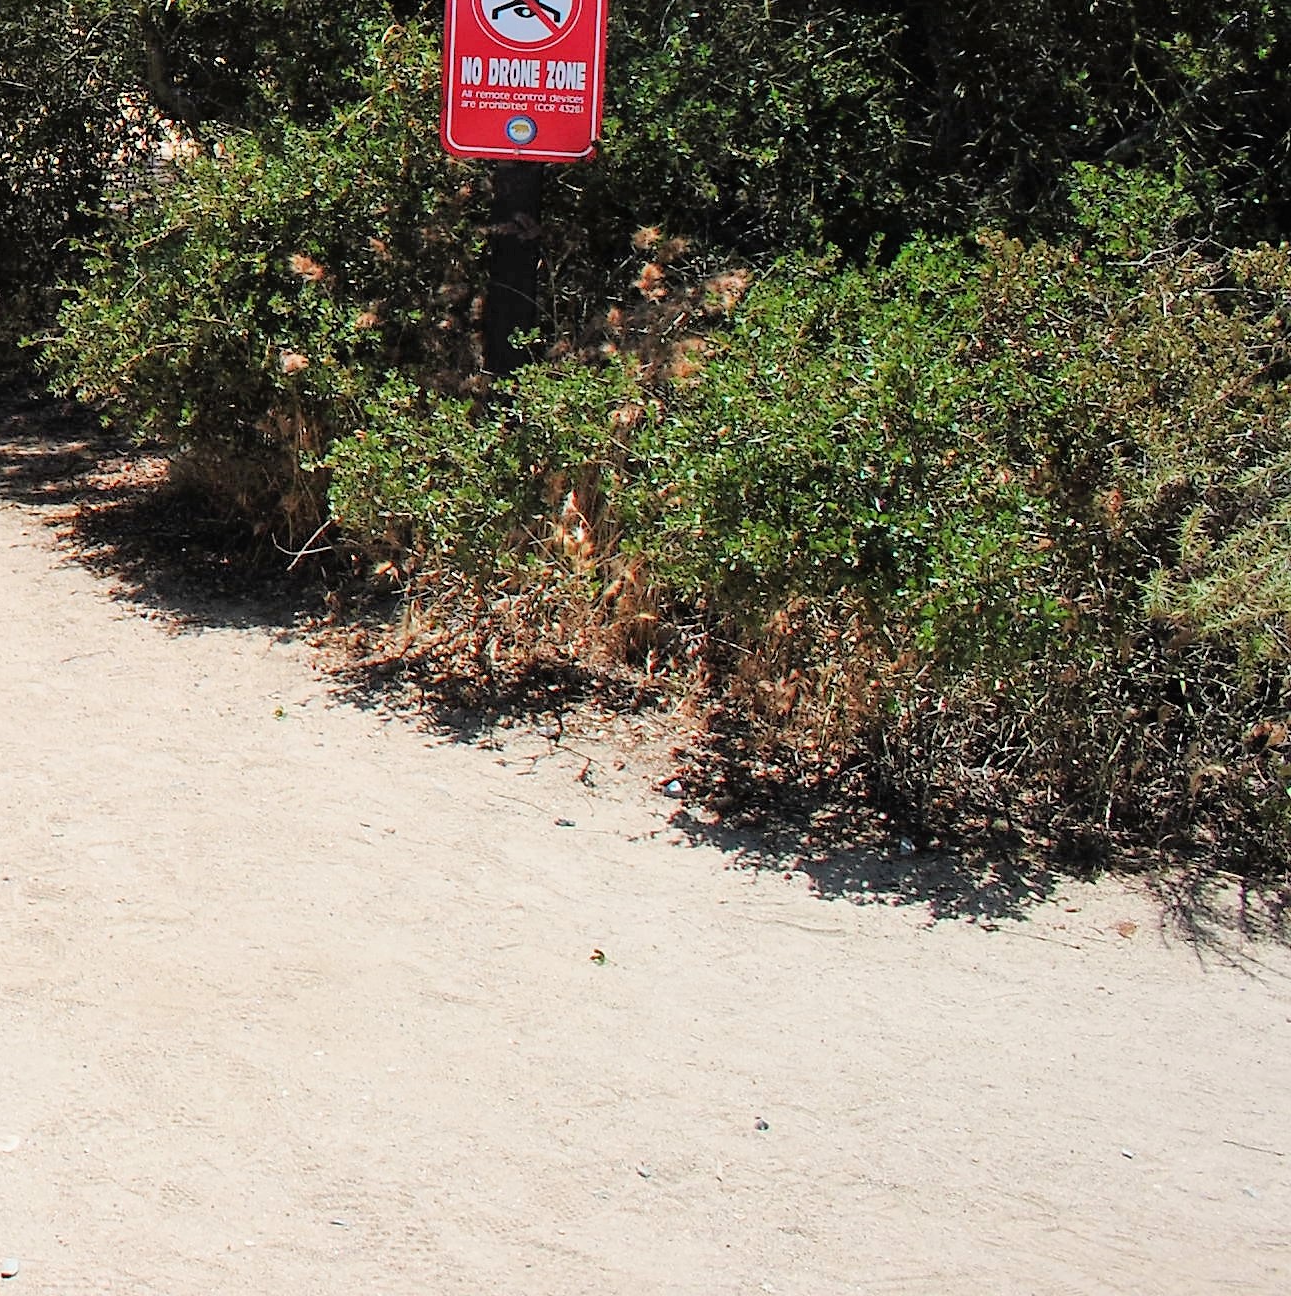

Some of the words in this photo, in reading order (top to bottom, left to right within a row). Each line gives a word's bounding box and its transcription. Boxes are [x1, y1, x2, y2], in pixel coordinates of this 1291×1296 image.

[461, 56, 483, 85] NO
[488, 57, 540, 89] DRONE
[545, 60, 587, 91] ZONE
[461, 89, 473, 98] All
[475, 90, 511, 101] remote
[513, 92, 546, 102] control
[549, 93, 585, 104] devices
[461, 100, 476, 108] are
[479, 100, 528, 111] prohibited
